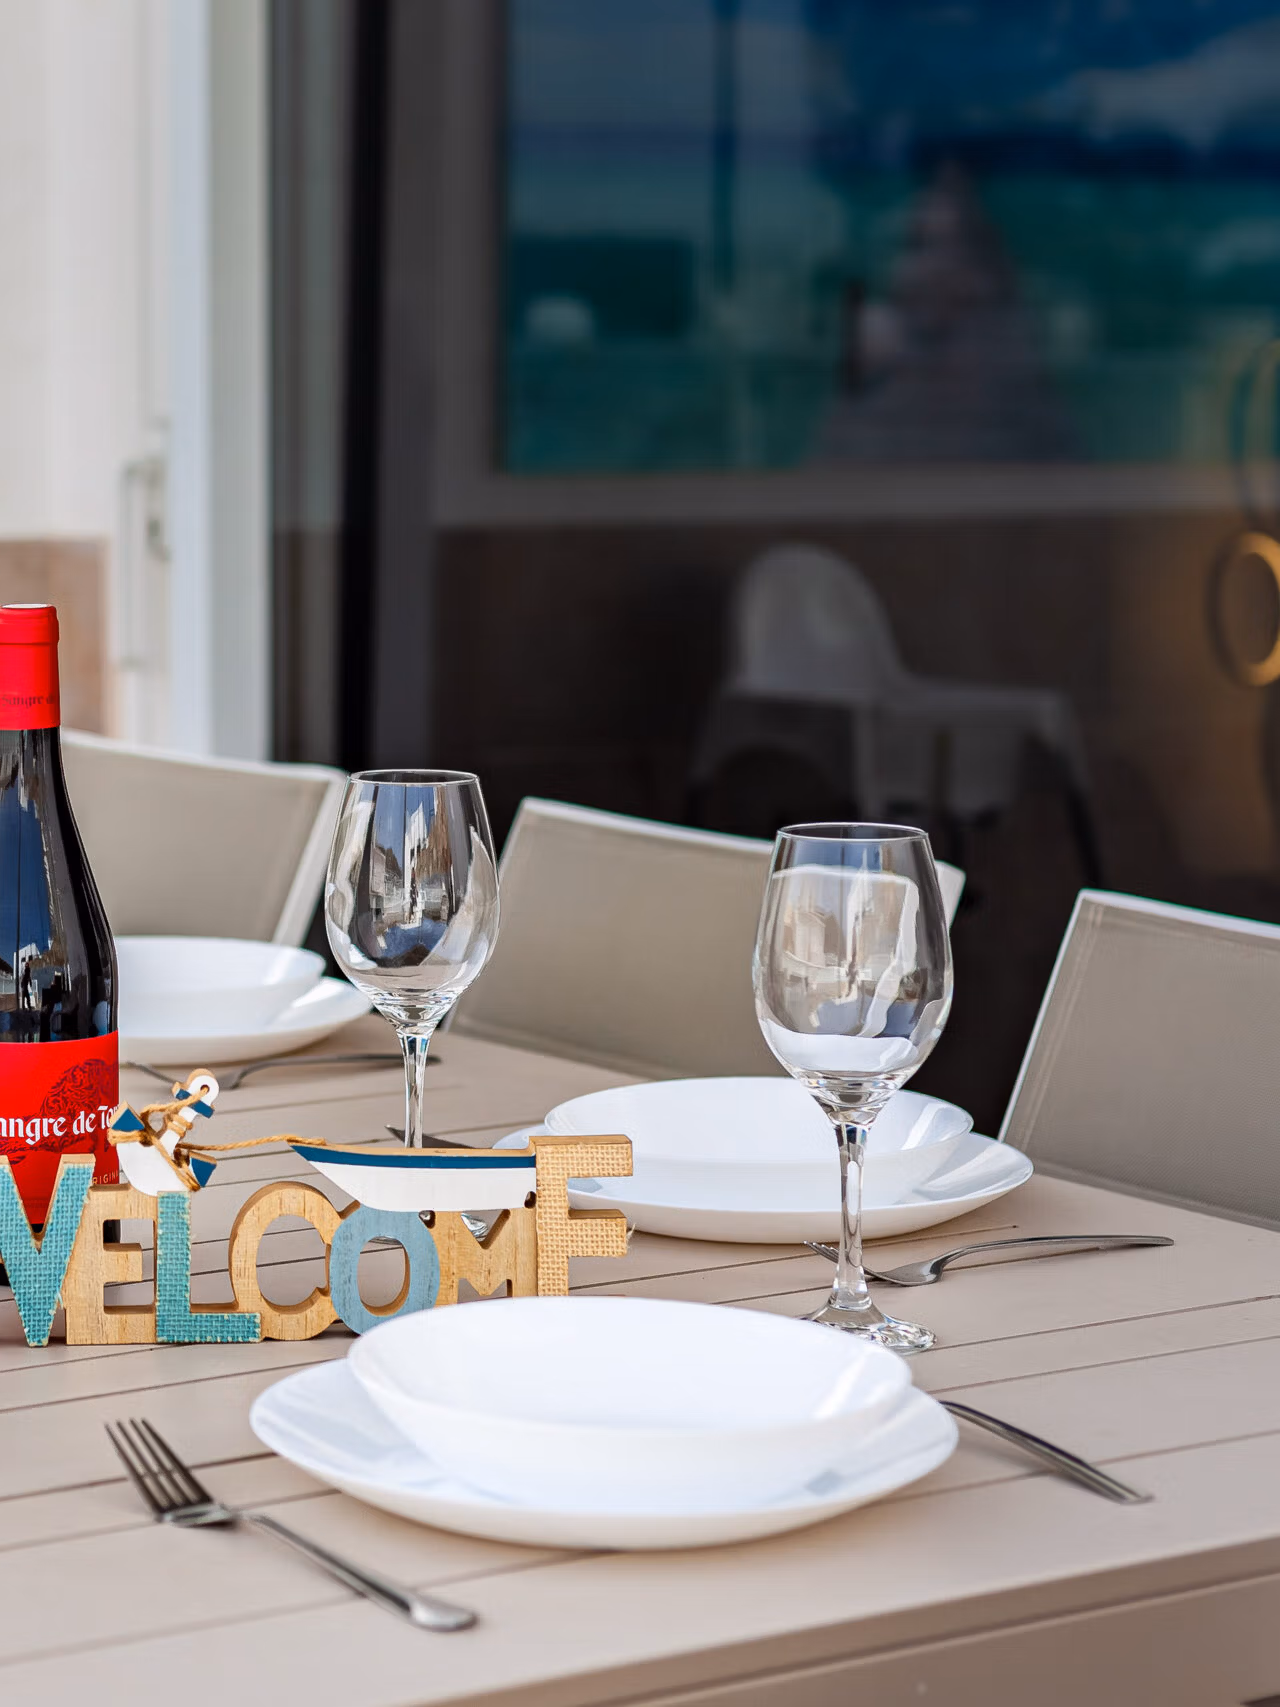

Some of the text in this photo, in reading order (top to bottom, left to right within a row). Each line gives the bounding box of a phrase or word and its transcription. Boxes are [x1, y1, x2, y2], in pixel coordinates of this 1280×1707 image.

[72, 1110, 96, 1136] de
[97, 1105, 119, 1130] To
[92, 1169, 119, 1185] RIGIN
